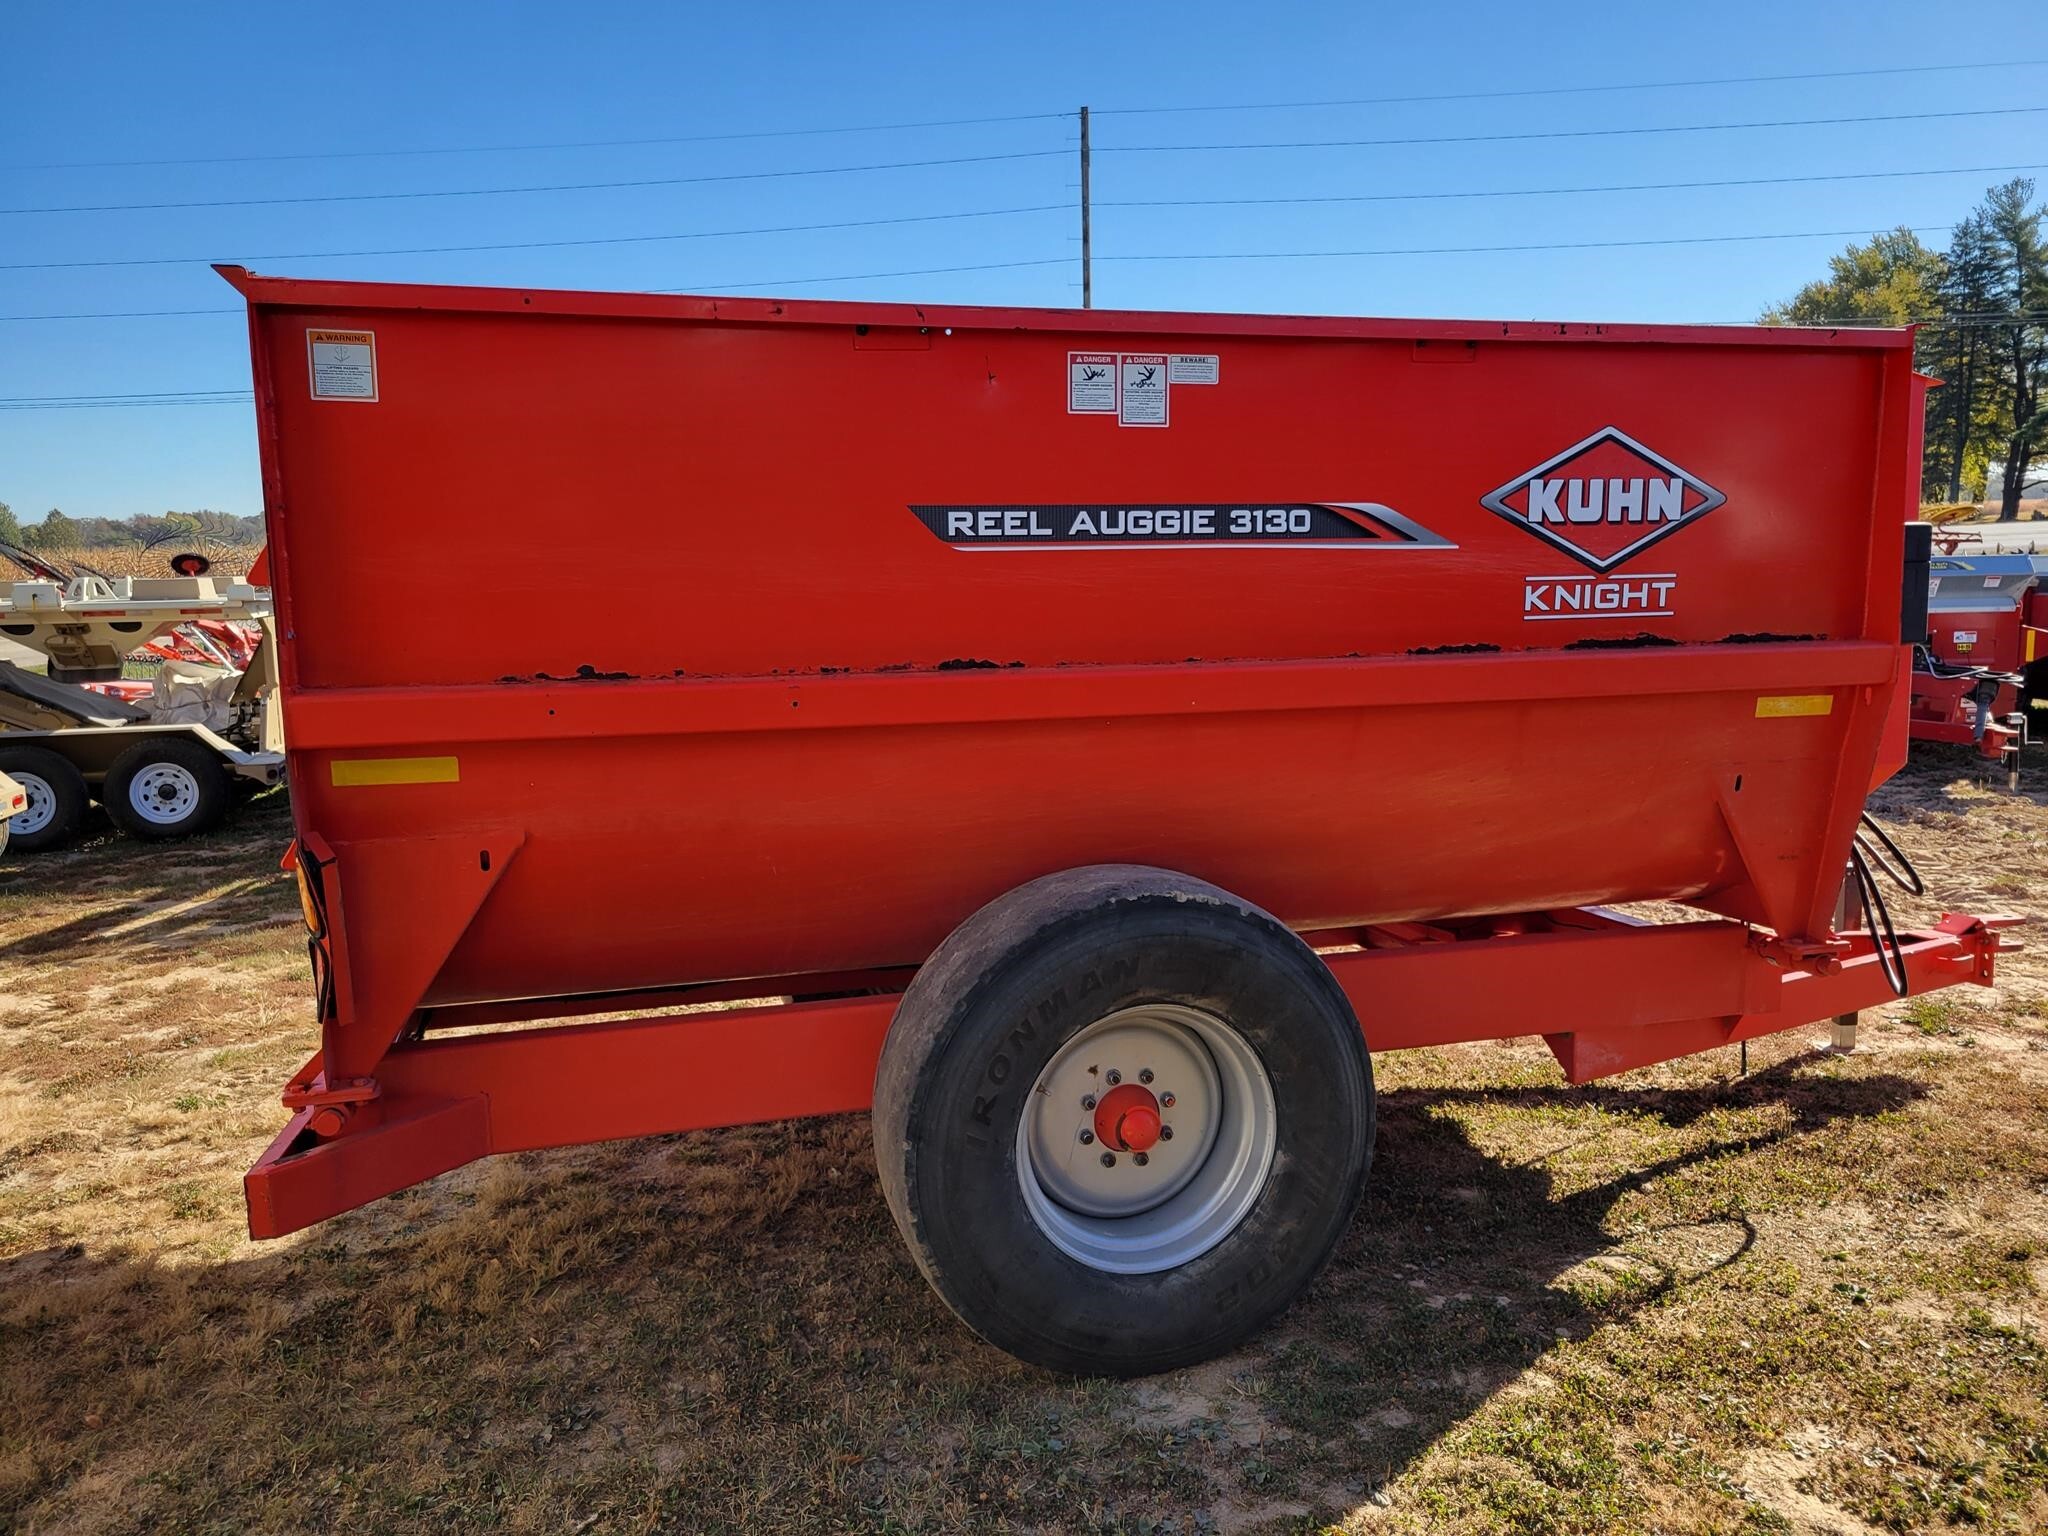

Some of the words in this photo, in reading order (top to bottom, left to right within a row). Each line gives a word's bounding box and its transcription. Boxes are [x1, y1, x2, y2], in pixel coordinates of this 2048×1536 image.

[325, 334, 367, 343] WARNING
[1083, 355, 1111, 363] DANGER
[1527, 477, 1684, 524] KUHN
[947, 511, 1054, 537] REEL
[1069, 509, 1216, 536] AUGGIE
[1229, 509, 1312, 534] 3130
[1523, 581, 1676, 612] KNIGHT
[966, 957, 1142, 1149] IRONMAN
